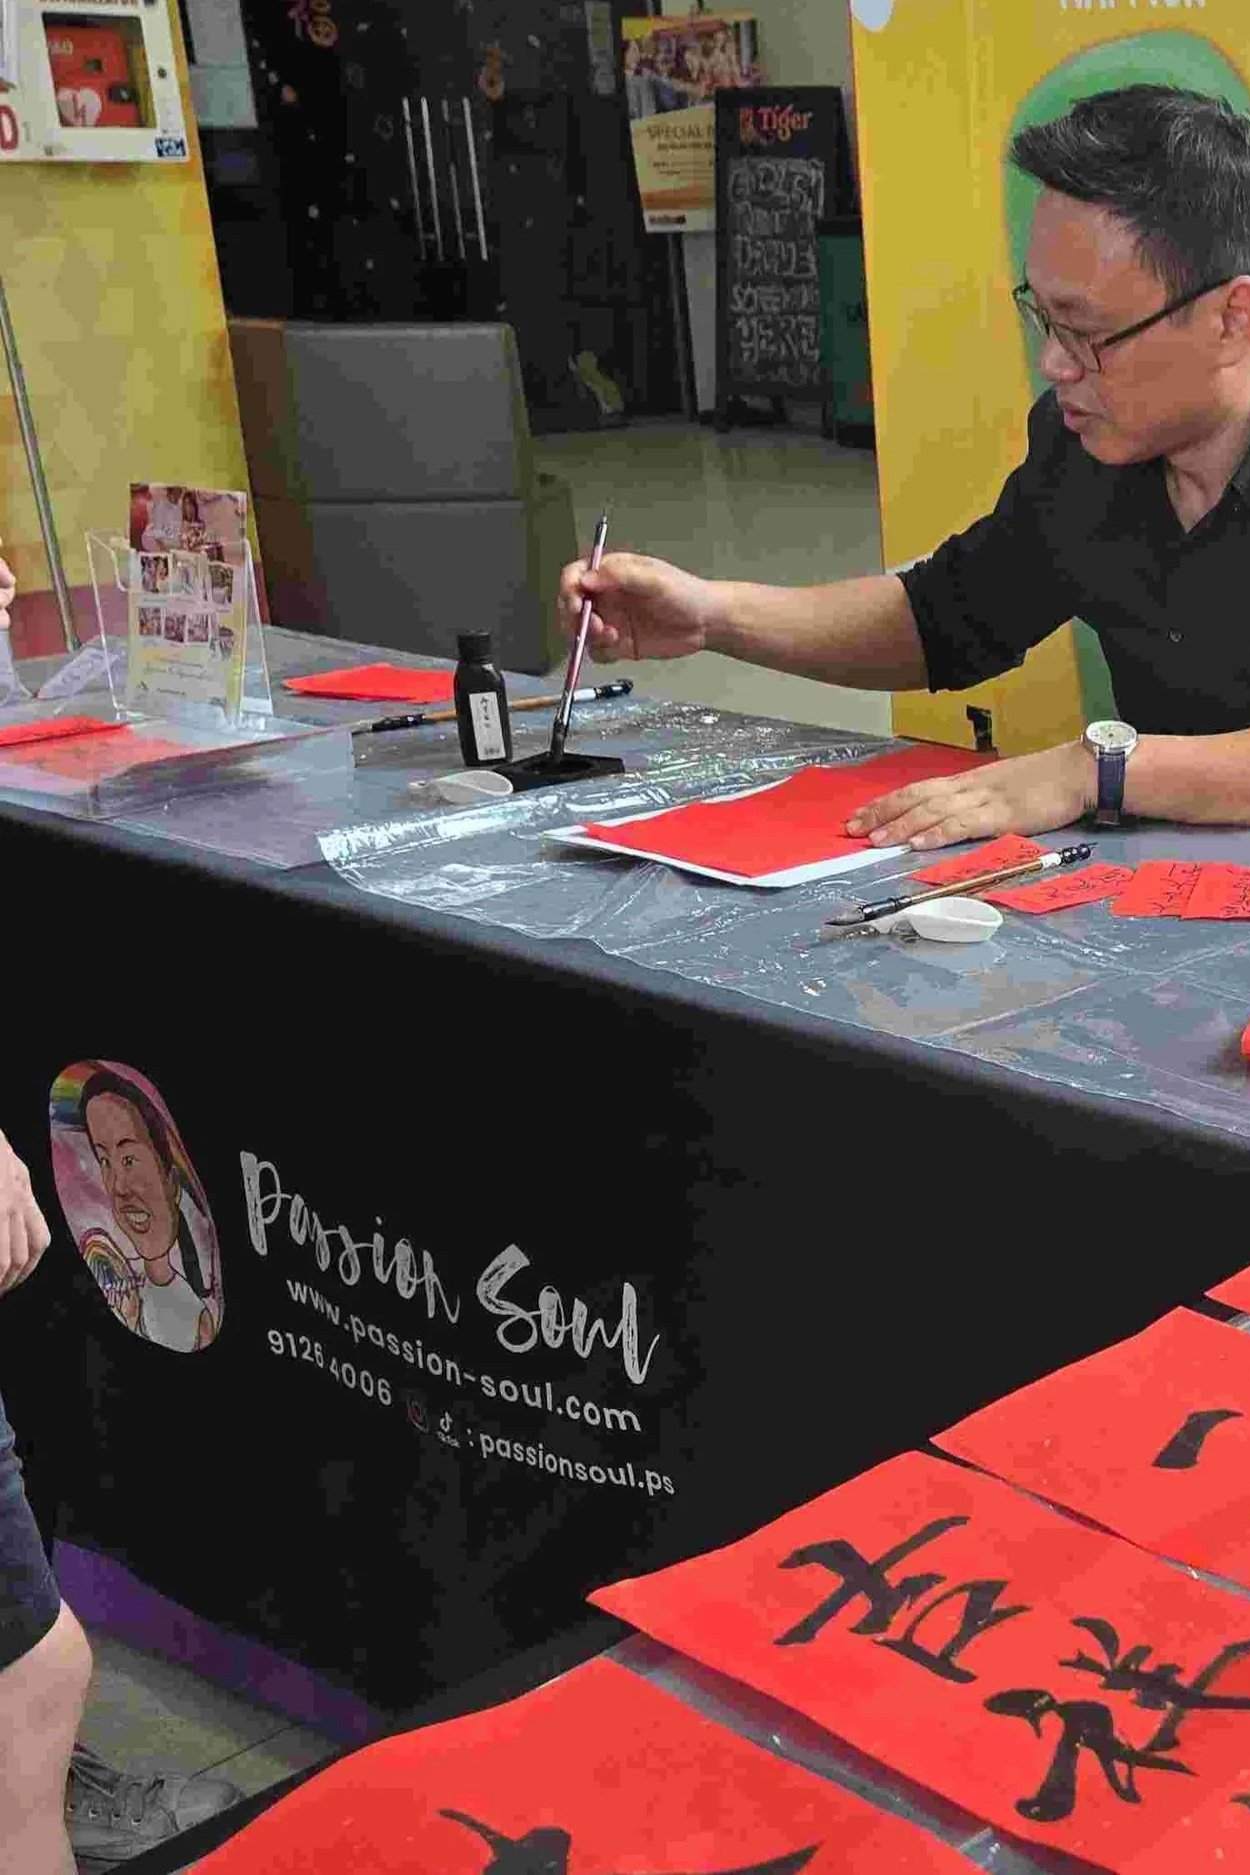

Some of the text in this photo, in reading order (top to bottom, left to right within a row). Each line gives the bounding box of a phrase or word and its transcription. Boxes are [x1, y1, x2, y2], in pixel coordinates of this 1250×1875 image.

[757, 104, 813, 141] Tiger
[240, 1150, 660, 1385] Passion Soul
[286, 1279, 642, 1432] www.passion-soul.com
